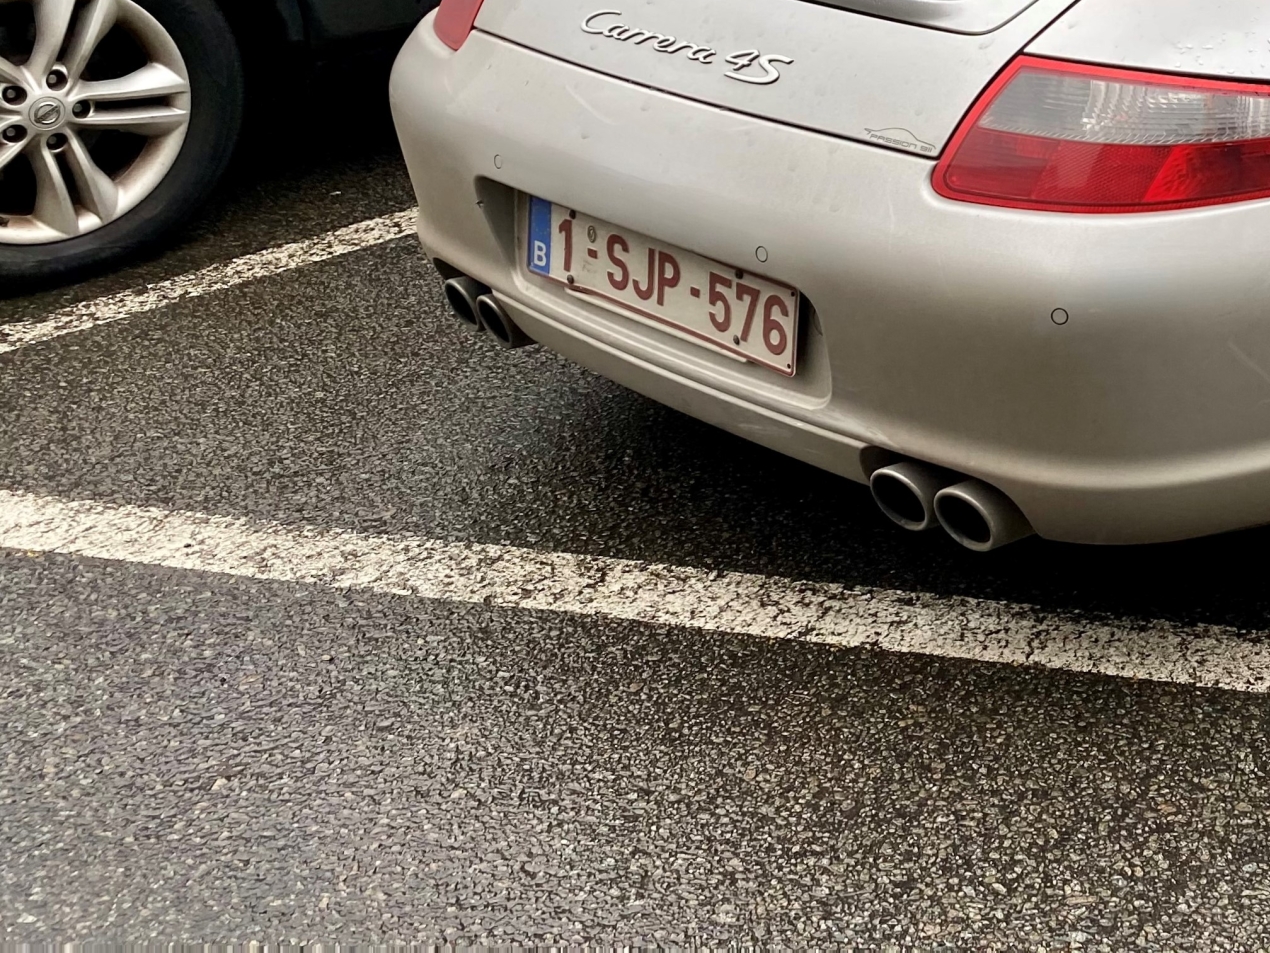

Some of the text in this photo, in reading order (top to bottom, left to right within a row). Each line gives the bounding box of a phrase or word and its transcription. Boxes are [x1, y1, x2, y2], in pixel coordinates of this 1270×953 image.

[581, 9, 794, 85] Carrera 4S
[870, 133, 917, 150] PASSION
[533, 240, 547, 268] B
[558, 218, 790, 356] 1-SJP-576
